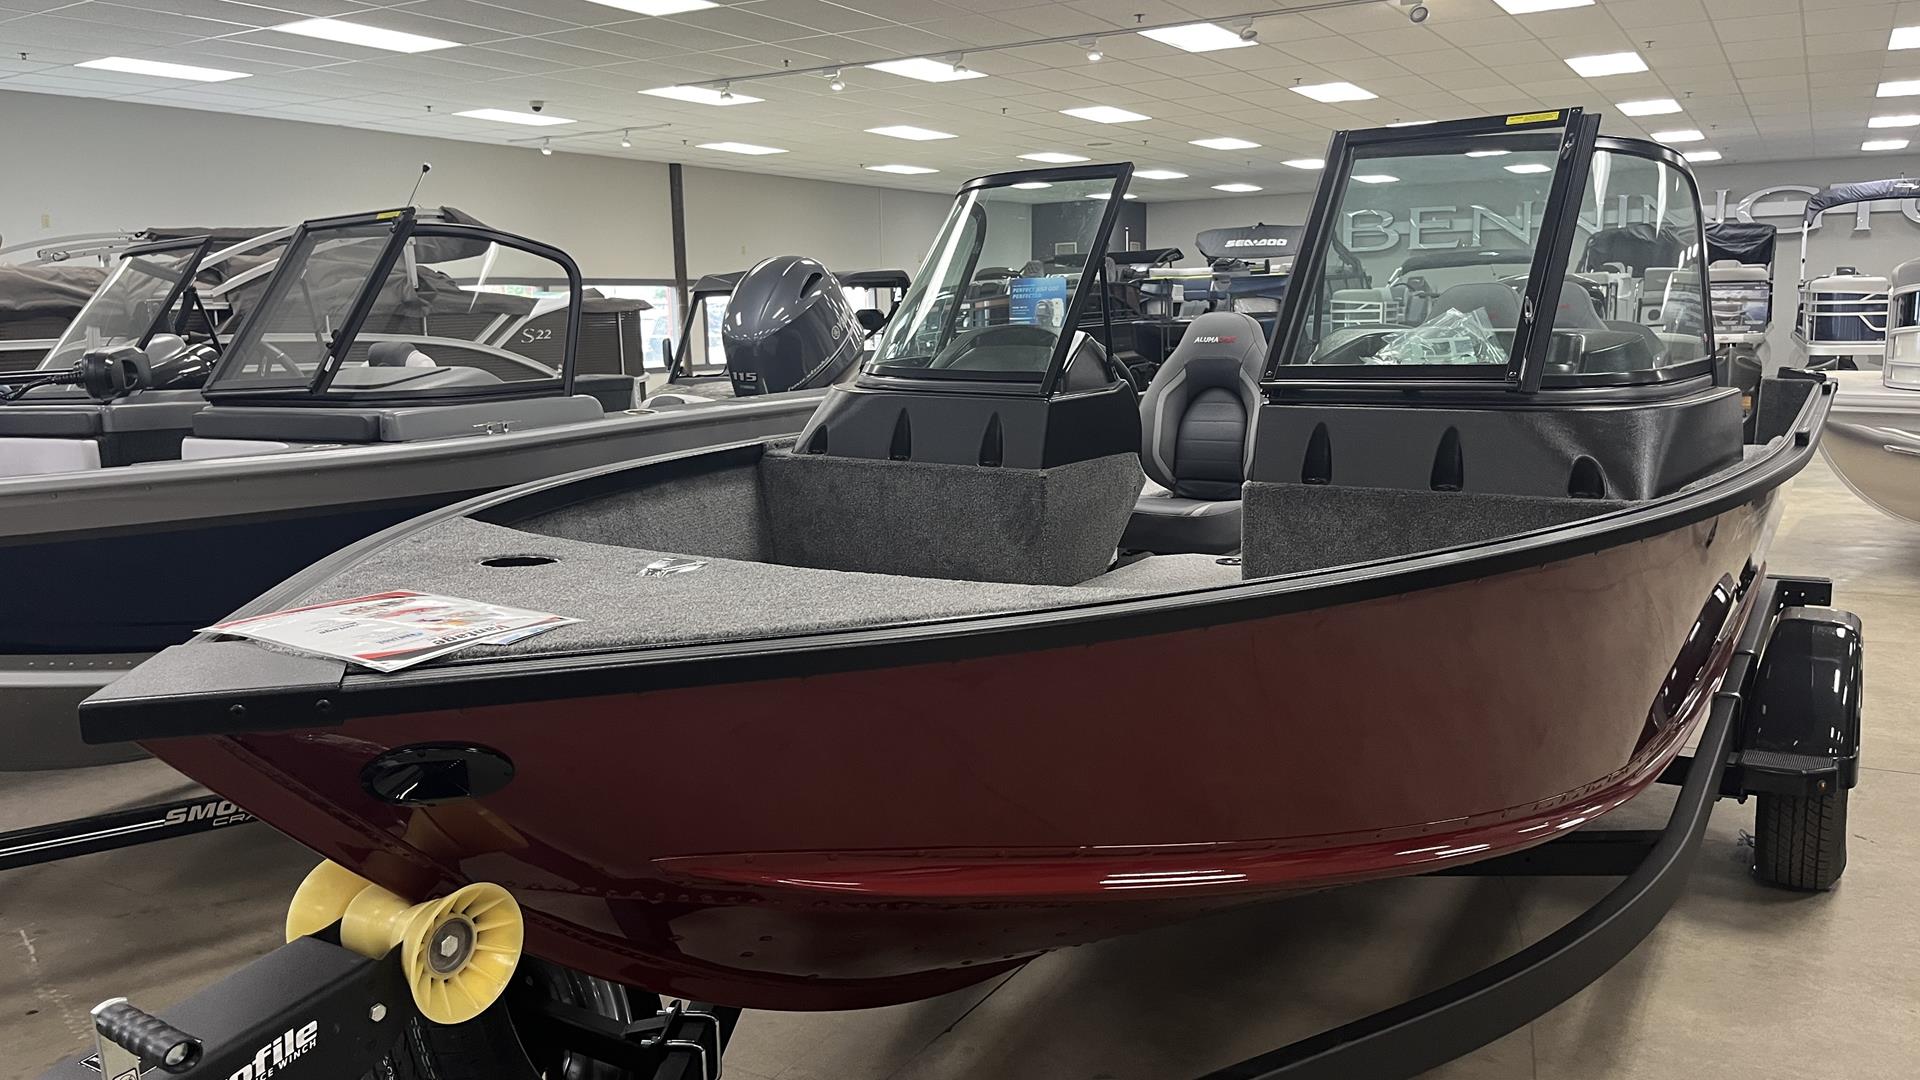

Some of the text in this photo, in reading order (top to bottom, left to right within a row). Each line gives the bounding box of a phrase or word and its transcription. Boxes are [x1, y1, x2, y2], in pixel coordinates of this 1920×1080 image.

[732, 371, 757, 382] 115
[432, 624, 511, 645] Vantage
[278, 1038, 317, 1070] WINCH
